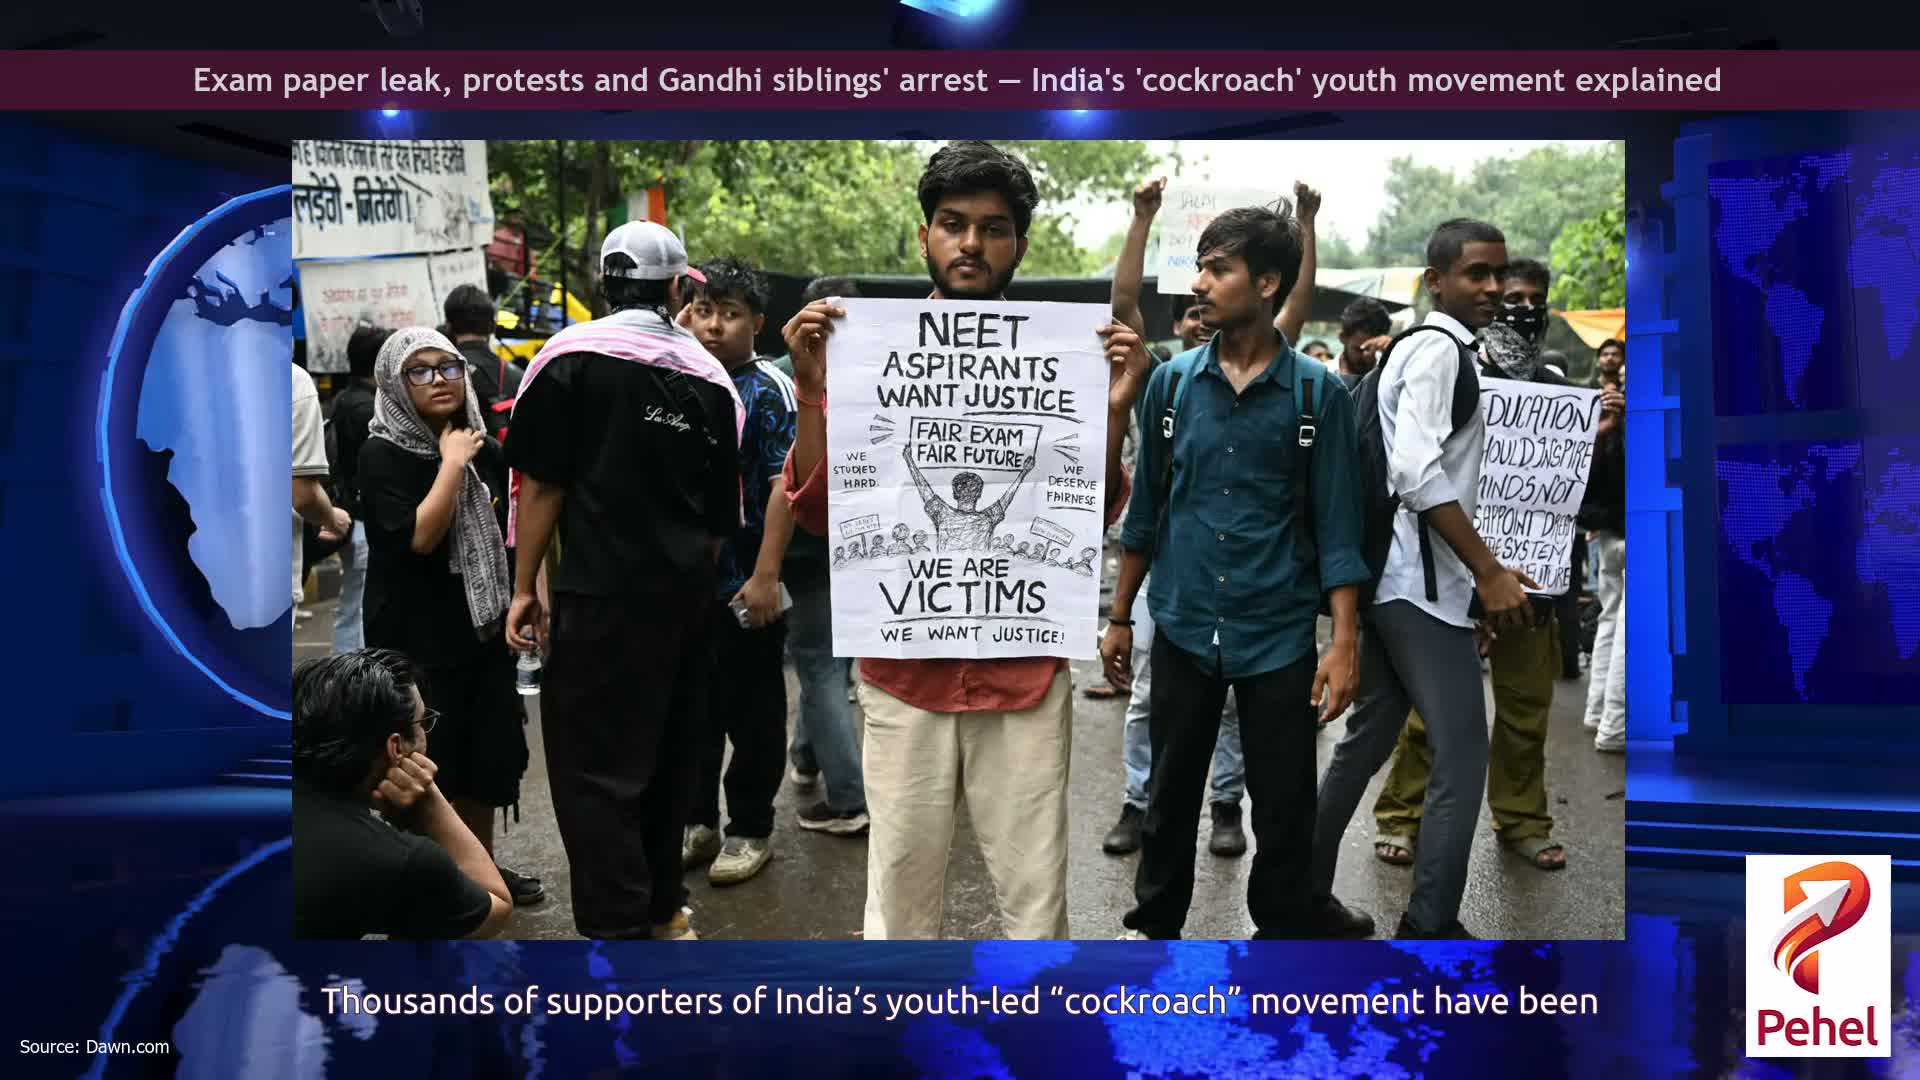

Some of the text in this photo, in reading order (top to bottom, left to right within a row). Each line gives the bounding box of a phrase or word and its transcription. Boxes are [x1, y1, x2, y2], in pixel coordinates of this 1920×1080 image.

[919, 312, 1029, 349] NEET
[882, 351, 1059, 383] ASPIRANTS
[877, 383, 1076, 413] WANT JUSTICE
[1481, 391, 1601, 435] DUCATION
[917, 422, 1023, 447] FAIR EXAM
[846, 451, 867, 462] WE
[917, 444, 1024, 469] FAIR FUTURE
[1482, 435, 1535, 468] HOULD
[833, 465, 877, 475] STUDIED
[1048, 475, 1097, 491] DESERVE
[1063, 465, 1085, 475] WE
[1532, 474, 1584, 505] NOT
[1475, 505, 1545, 537] SAPPOINT
[1502, 537, 1567, 565] SYSTEM
[908, 558, 1010, 579] WE ARE
[878, 580, 1047, 615] VICTIMS
[880, 625, 1065, 645] WE WANT JUSTICE!
